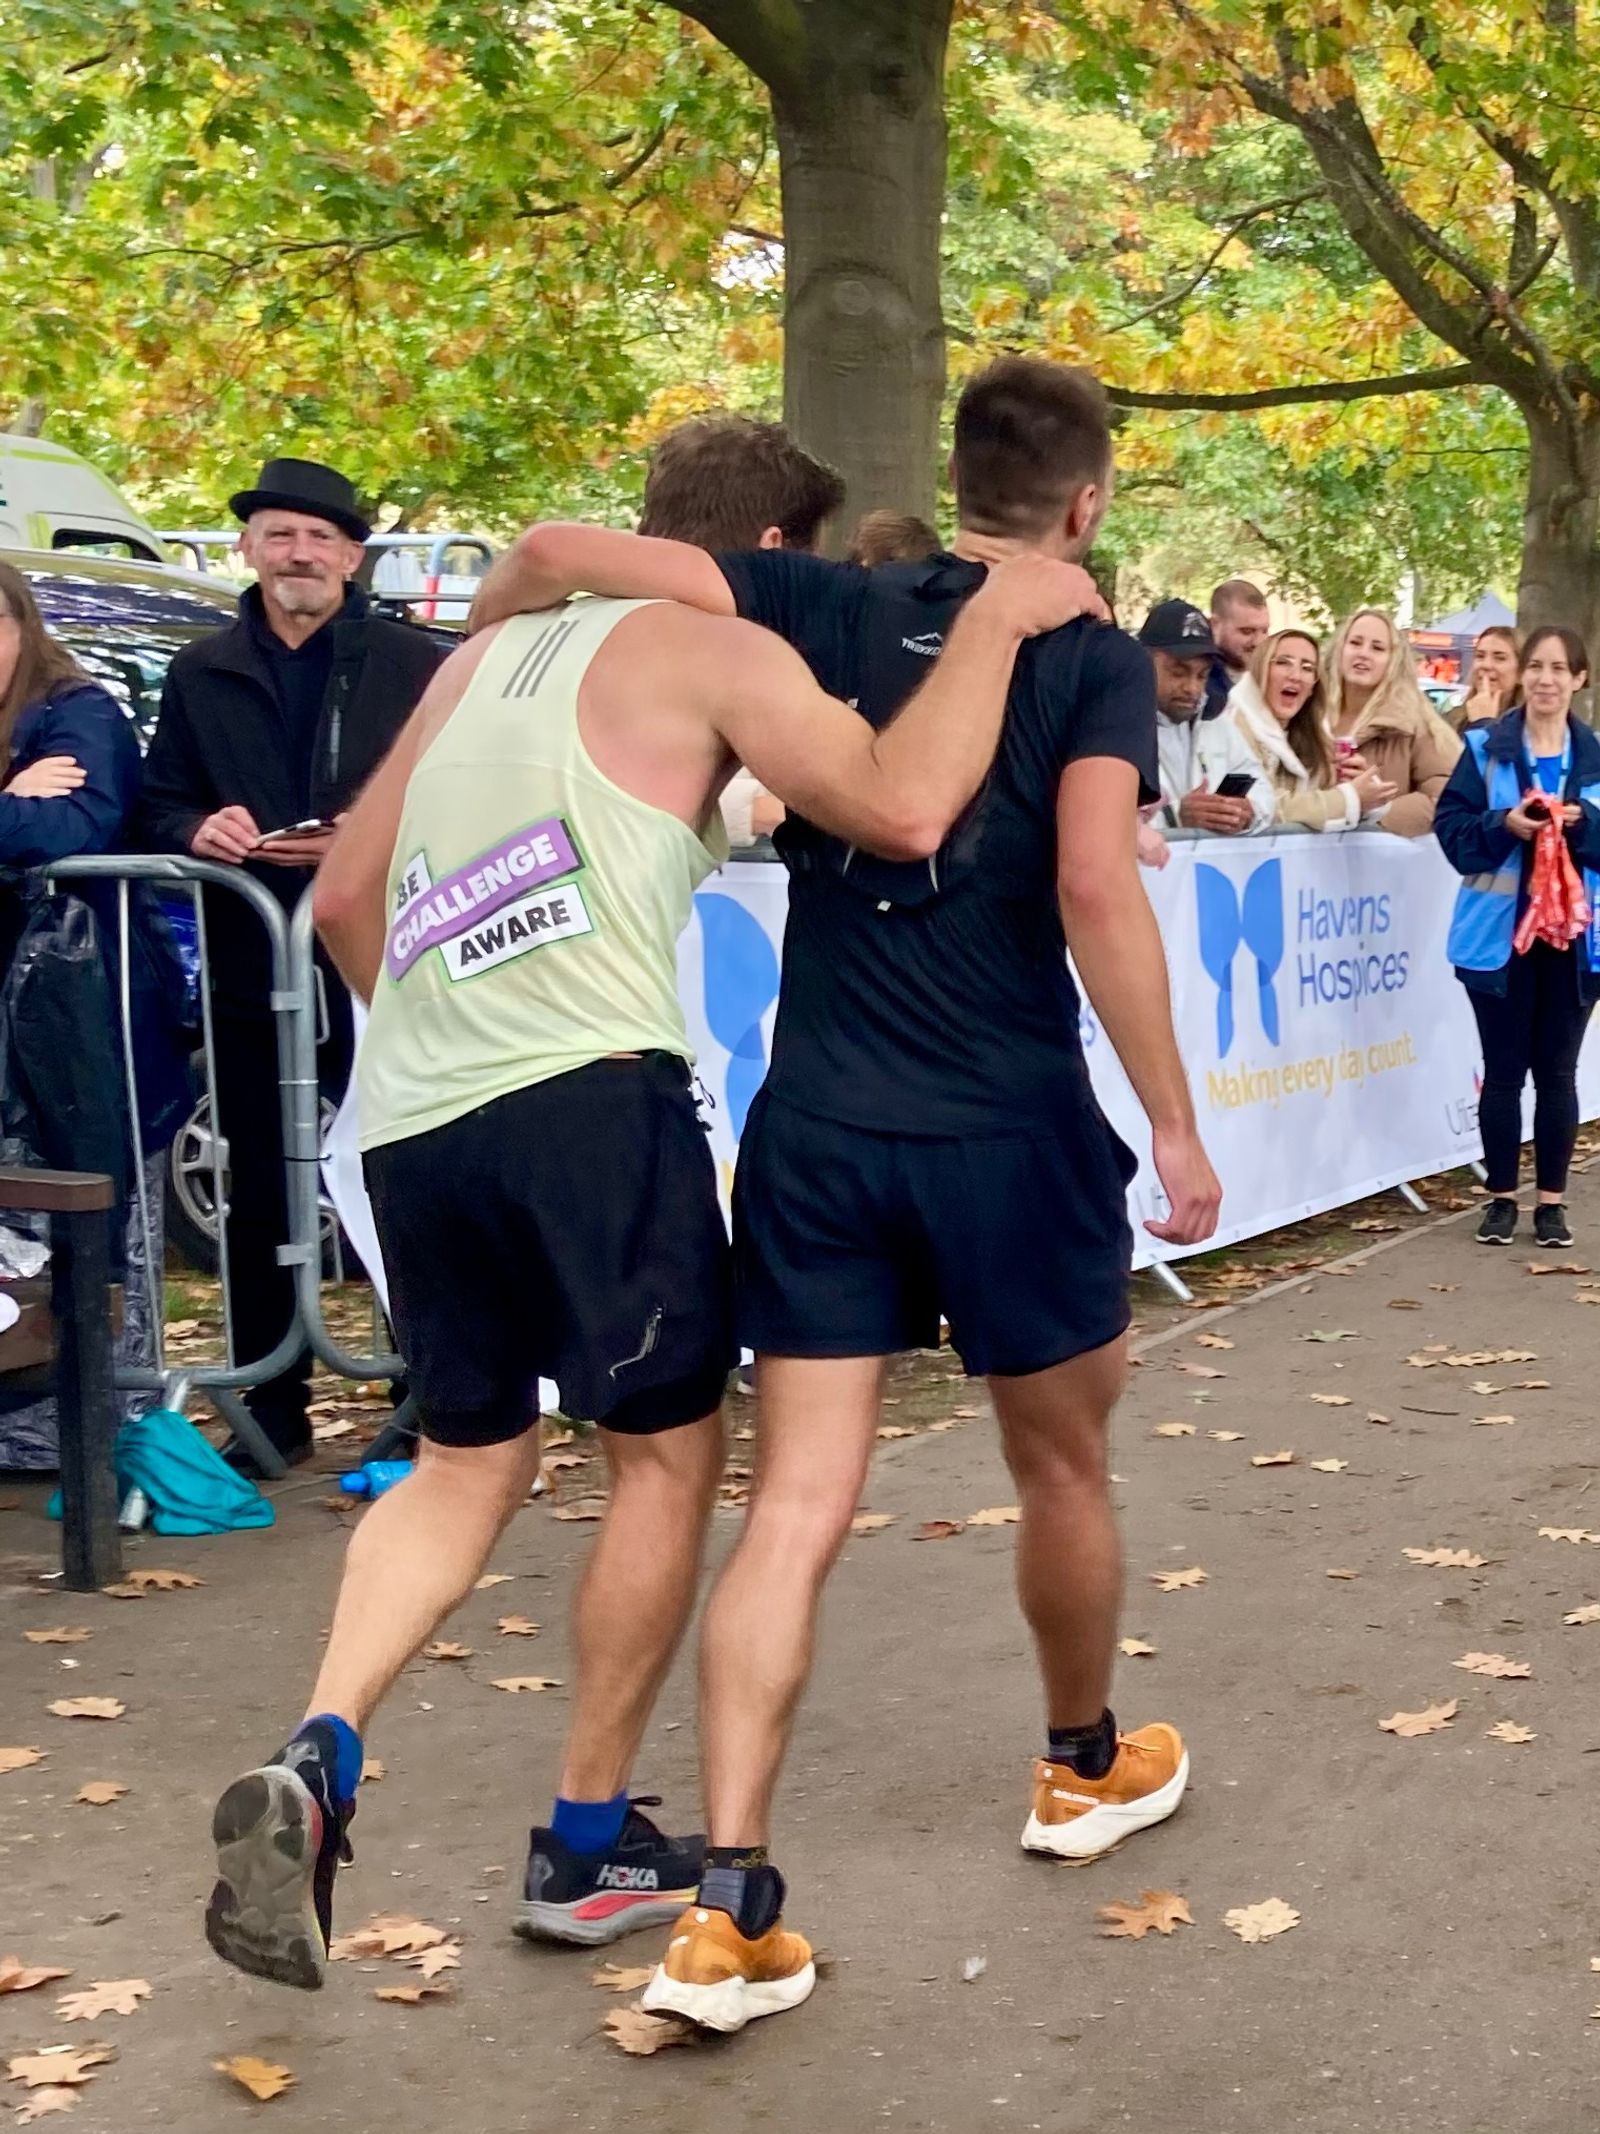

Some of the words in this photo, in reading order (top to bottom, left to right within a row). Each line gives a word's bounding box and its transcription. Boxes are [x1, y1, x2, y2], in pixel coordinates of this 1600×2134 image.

[392, 833, 559, 960] CHALLENGE
[396, 871, 421, 911] BE
[1297, 887, 1391, 943] Havens
[460, 899, 571, 967] AWARE
[1297, 941, 1409, 1013] Hospices
[1282, 1055, 1335, 1098] every
[596, 1863, 659, 1890] HOKA
